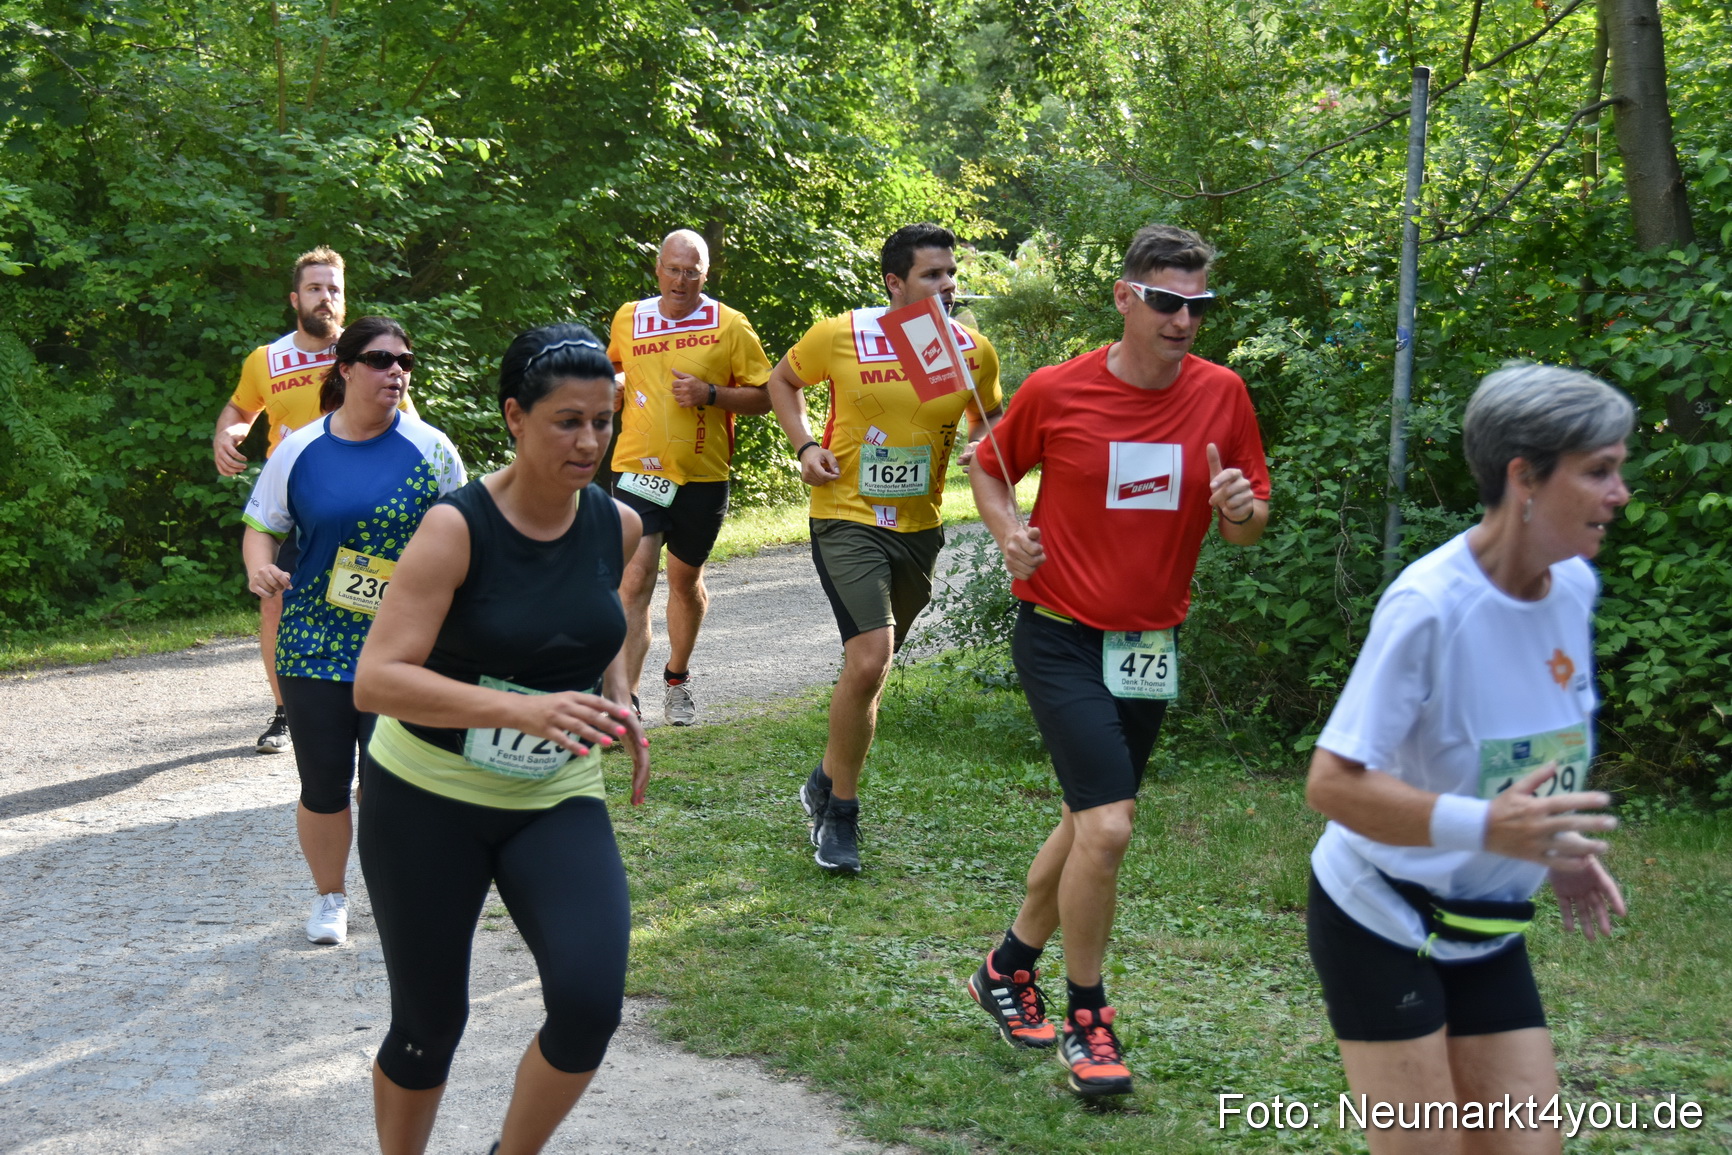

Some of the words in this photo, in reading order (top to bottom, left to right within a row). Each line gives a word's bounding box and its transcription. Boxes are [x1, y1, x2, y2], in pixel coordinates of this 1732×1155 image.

[632, 340, 670, 357] MAX
[675, 334, 720, 350] BÖGL
[271, 375, 314, 394] MAX
[868, 464, 919, 483] 1621
[632, 473, 671, 494] 1558
[1131, 481, 1156, 493] DEHN
[338, 591, 374, 605] Laussmann
[1119, 652, 1168, 679] 475
[1140, 679, 1166, 687] Thomas
[492, 728, 572, 755] 172
[497, 749, 525, 762] Ferstl
[526, 754, 557, 764] Sandra
